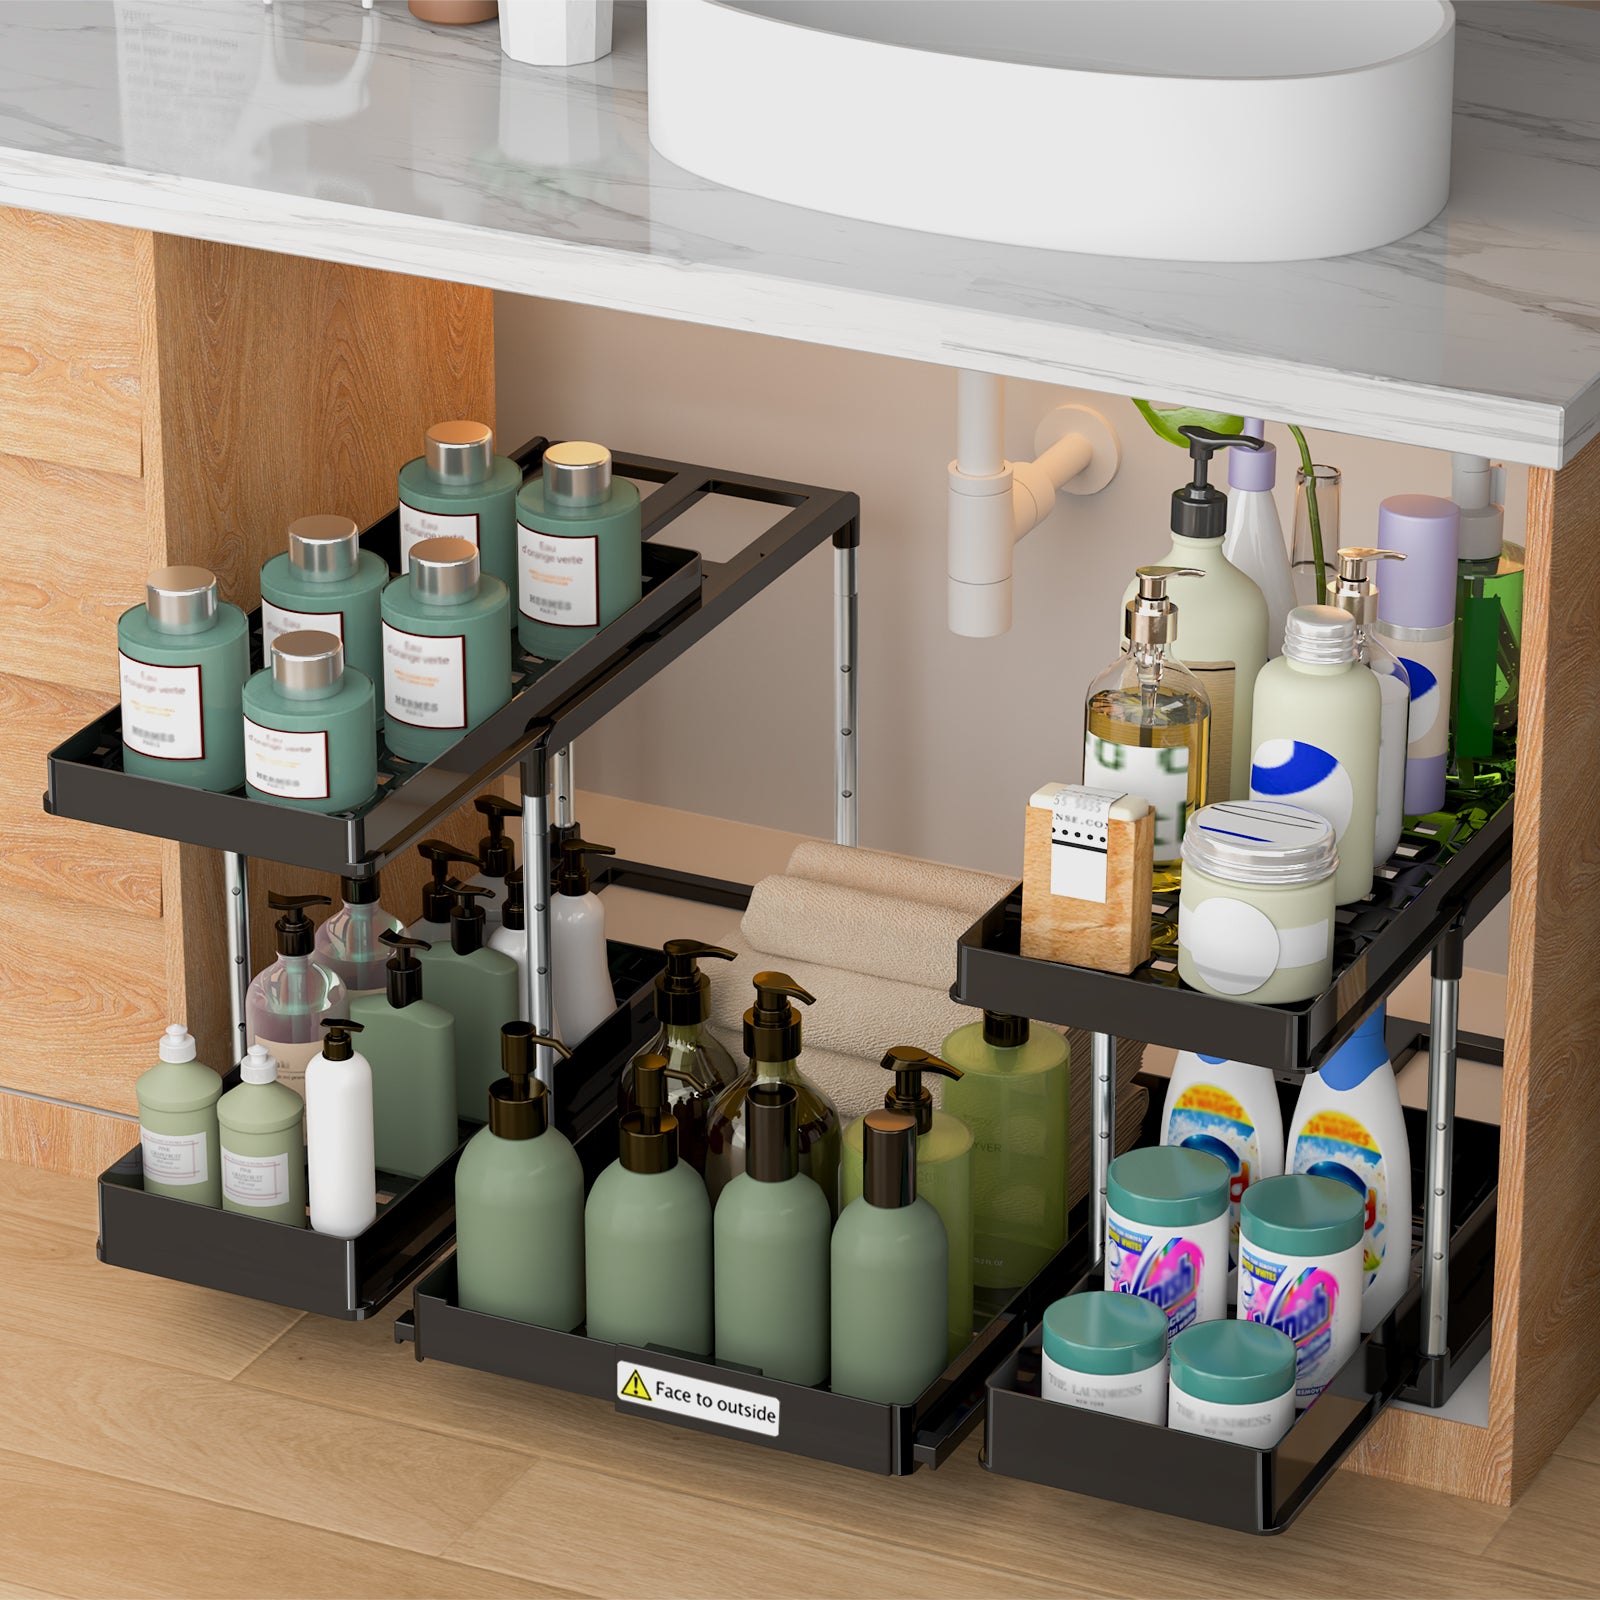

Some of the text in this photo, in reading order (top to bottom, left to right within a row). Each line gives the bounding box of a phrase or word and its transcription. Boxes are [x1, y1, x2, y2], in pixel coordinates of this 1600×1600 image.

[656, 1381, 776, 1423] Face to outside
